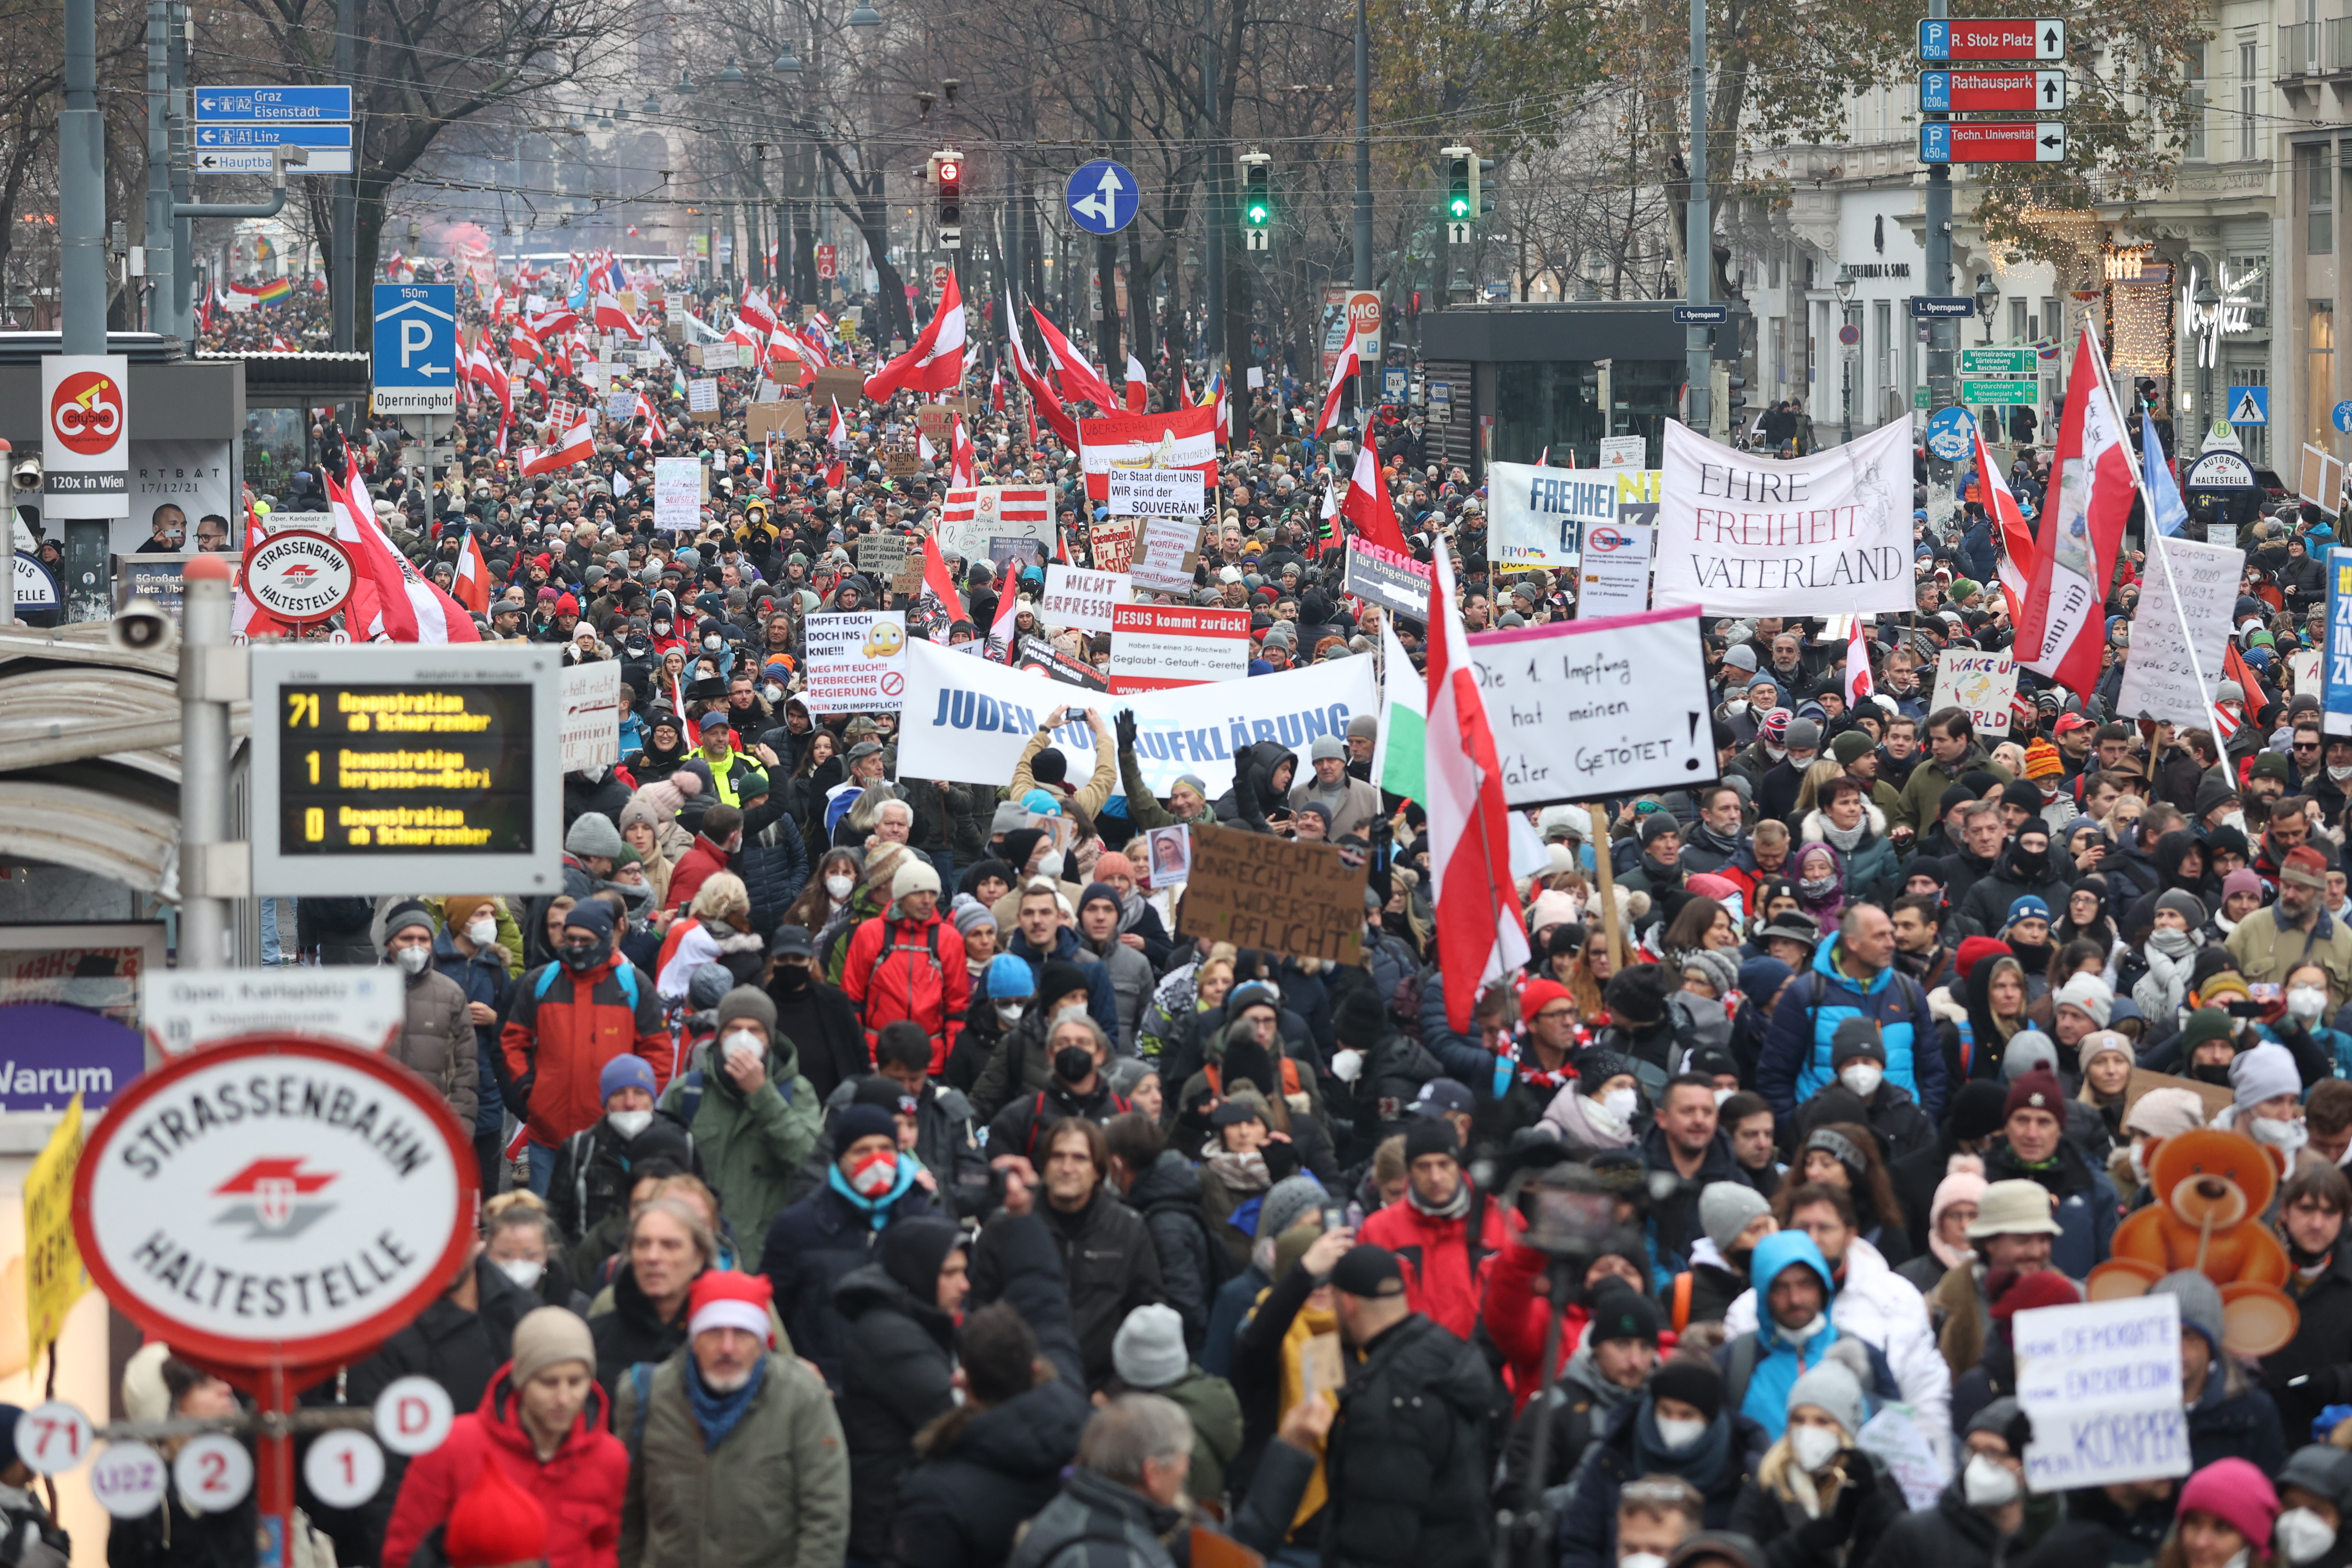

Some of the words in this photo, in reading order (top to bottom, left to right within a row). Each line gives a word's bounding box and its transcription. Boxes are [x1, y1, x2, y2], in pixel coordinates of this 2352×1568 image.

[1952, 34, 1963, 47] R.
[1967, 33, 1999, 47] Stolz
[2003, 33, 2033, 46] Platz
[1923, 46, 1939, 56] 750
[1952, 75, 2033, 91] Rathauspark
[254, 91, 282, 101] Graz
[1923, 97, 1941, 107] 1200
[238, 99, 250, 109] A2
[255, 106, 320, 117] Eisenstadt
[239, 131, 251, 142] A1
[254, 131, 279, 142] Linz
[1952, 130, 1983, 140] Techn.
[1985, 130, 2034, 139] Universität
[1924, 148, 1939, 158] 450
[1891, 263, 1909, 277] SONS
[401, 288, 428, 298] 150m
[1351, 303, 1380, 320] MQ
[1927, 303, 1966, 313] Operngasse
[1687, 311, 1720, 320] Operngasse
[401, 320, 433, 368] P
[377, 394, 453, 409] Opernringhof
[67, 413, 109, 425] citybike
[923, 413, 941, 423] NEIN
[890, 453, 915, 462] NEIN
[1090, 456, 1158, 465] EXPERIMENTELLE
[1162, 447, 1210, 462] INJEKTIONEN
[2204, 456, 2241, 469] AUTOBUS
[52, 476, 80, 488] 120x
[84, 475, 96, 488] in
[100, 475, 124, 488] Wien
[1112, 471, 1127, 481] Der
[1130, 472, 1152, 481] Staat
[1155, 472, 1177, 482] dient
[1179, 474, 1201, 482] UNS!
[1698, 462, 1810, 503] EHRE
[141, 484, 199, 493] 17/12/21
[1112, 486, 1130, 496] WIR
[1134, 487, 1153, 497] sind
[1157, 487, 1172, 497] der
[1132, 501, 1199, 514] SOUVERÄN!
[967, 520, 1003, 533] Österreich
[1694, 504, 1865, 546] FREIHEIT
[1161, 531, 1188, 539] meinen
[963, 538, 976, 547] DEMO
[1150, 539, 1184, 550] KÖRPER
[257, 542, 344, 572] STRASSENBAHN
[1095, 545, 1108, 560] für
[1356, 554, 1371, 567] für
[1690, 546, 1901, 588] VATERLAND
[1131, 569, 1191, 585] verantwortlich
[2192, 569, 2220, 581] 2020
[136, 585, 162, 593] Netz.
[1066, 575, 1116, 595] NICHT
[260, 585, 340, 610] HALTESTELLE
[808, 617, 840, 626] IMPFT
[843, 616, 872, 624] EUCH
[1115, 611, 1152, 626] JESUS
[1157, 614, 1197, 628] kommt
[1200, 618, 1246, 631] zurück!
[809, 632, 839, 641] DOCH
[842, 631, 860, 640] INS
[809, 646, 844, 656] KNIE!!!
[853, 663, 887, 671] EUCH!!!
[1025, 648, 1052, 666] MUSS
[1053, 662, 1083, 682] WEG!!!
[1028, 638, 1056, 656] DIESE
[1055, 652, 1108, 684] REGIERUNG
[1114, 655, 1156, 665] Geglaubt
[1165, 658, 1199, 667] Getauft
[1208, 661, 1245, 670] Gerettet
[1950, 658, 2018, 674] WAKE-UP
[1472, 661, 1505, 688] Die
[1527, 658, 1541, 682] 1.
[1564, 652, 1631, 685] Impfung
[591, 675, 614, 694] nicht
[810, 675, 877, 684] VERBRECHER
[811, 687, 877, 697] REGIERUNG
[288, 693, 319, 728] 71
[933, 689, 1039, 735] JUDEN
[1511, 702, 1542, 727] hat
[1569, 701, 1629, 721] meinen
[305, 750, 319, 784] 1
[1247, 837, 1330, 874] RECHT
[1194, 854, 1298, 893] UNRECHT
[1233, 888, 1362, 929] WIDERSTAND
[1229, 915, 1348, 958] PFLICHT
[123, 1075, 431, 1179] STRASSENBAHN
[131, 1230, 418, 1319] HALTESTELLE
[398, 1397, 429, 1435] D
[31, 1418, 79, 1458] 71
[200, 1453, 227, 1492] 2
[337, 1449, 353, 1484] 1
